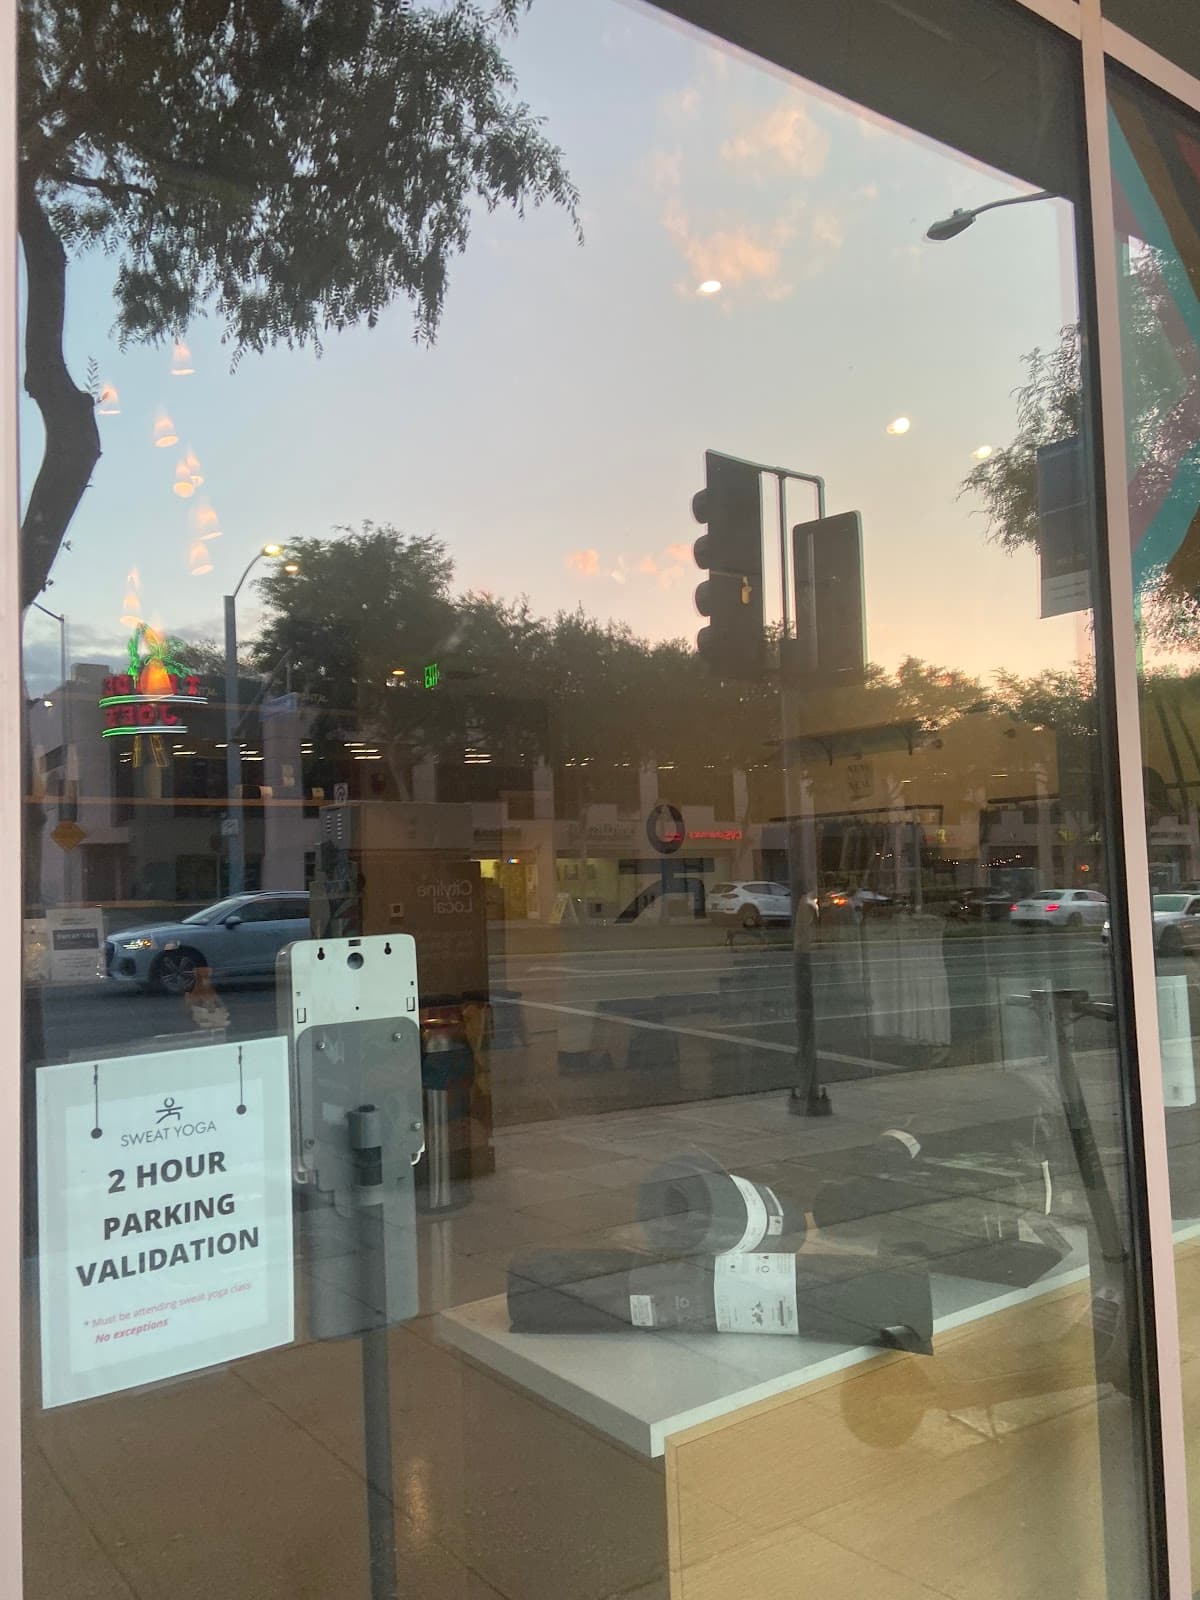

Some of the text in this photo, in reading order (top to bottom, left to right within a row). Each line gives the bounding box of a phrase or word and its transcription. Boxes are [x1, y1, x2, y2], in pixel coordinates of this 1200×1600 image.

[120, 1120, 217, 1148] SWEAT YOGA
[108, 1150, 227, 1194] 2 HOUR
[104, 1193, 235, 1241] PARKING
[75, 1226, 259, 1287] VALIDATION
[92, 1313, 117, 1328] Must
[119, 1310, 131, 1321] be
[133, 1299, 178, 1317] attending
[179, 1291, 207, 1306] sweat
[207, 1287, 229, 1302] yoga
[94, 1318, 169, 1344] No exceptions
